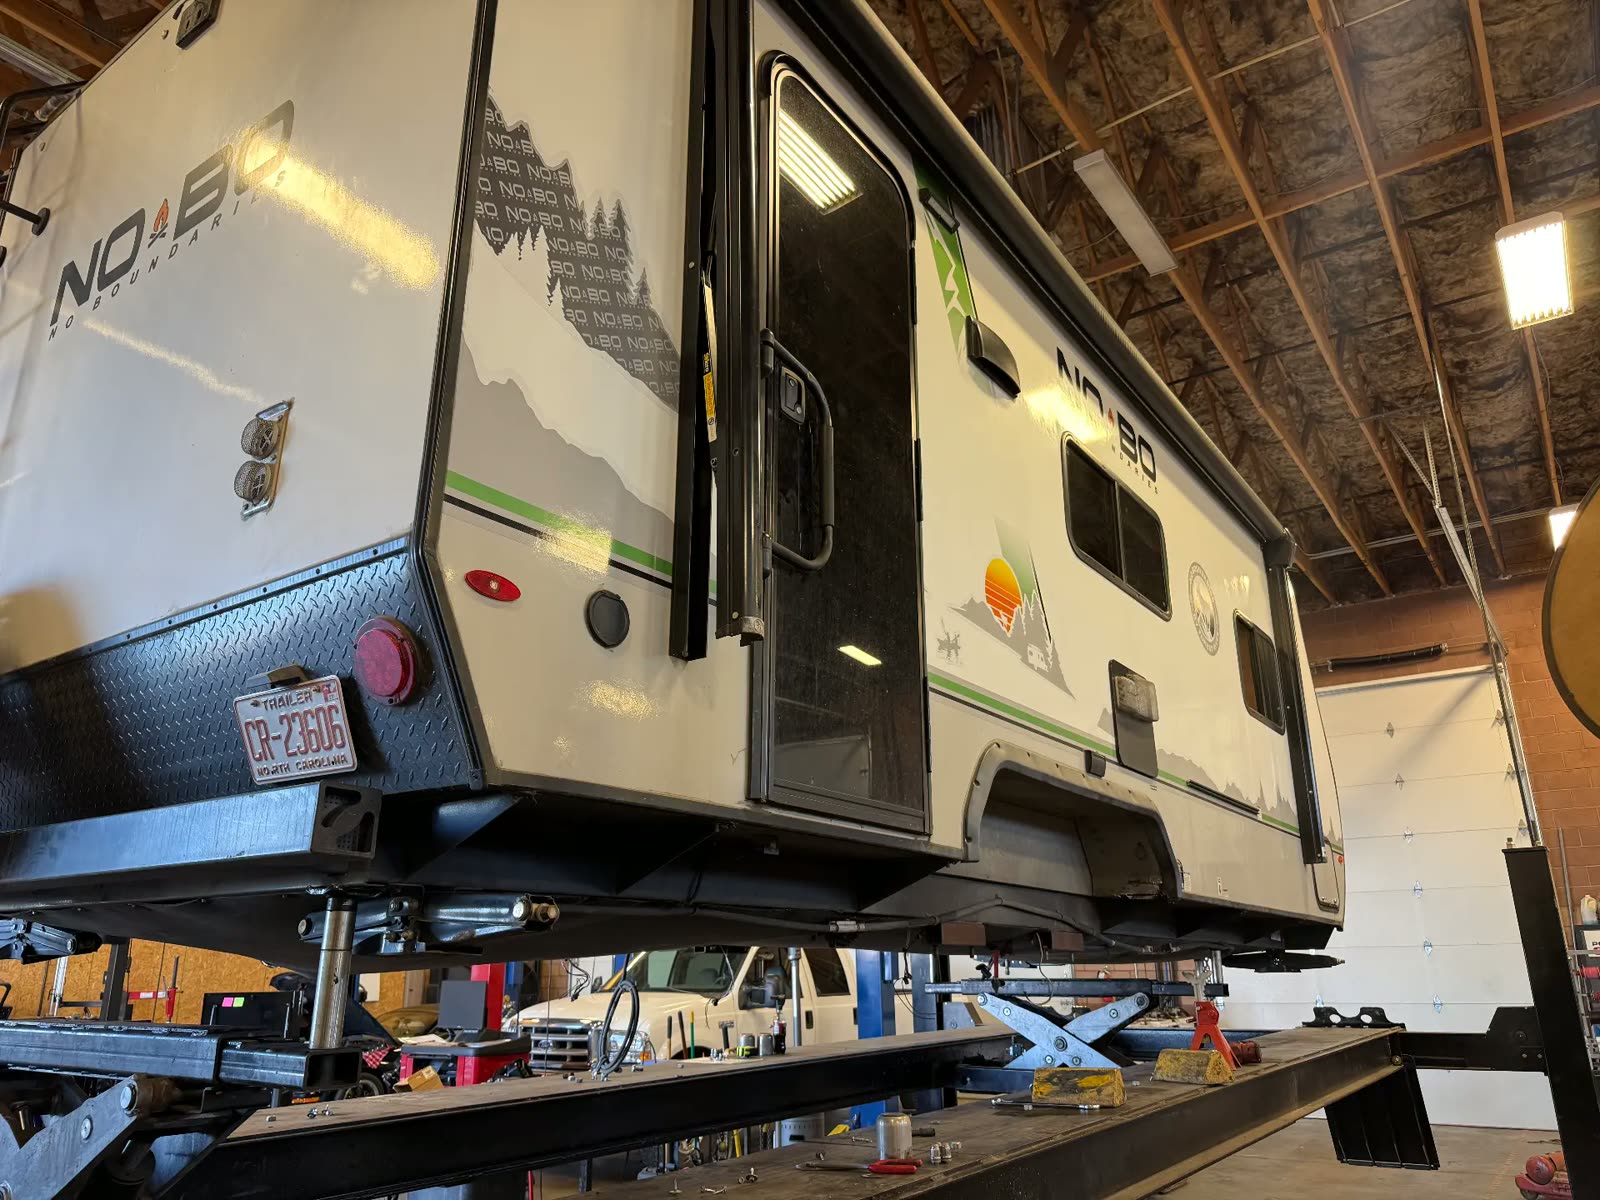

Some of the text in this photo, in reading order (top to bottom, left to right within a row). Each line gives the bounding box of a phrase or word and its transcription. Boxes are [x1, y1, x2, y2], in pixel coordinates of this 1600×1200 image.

[48, 315, 74, 341] NO
[262, 687, 313, 712] TRAILER
[244, 701, 346, 762] CR-23606
[256, 752, 348, 777] NORTH CAROLINA
